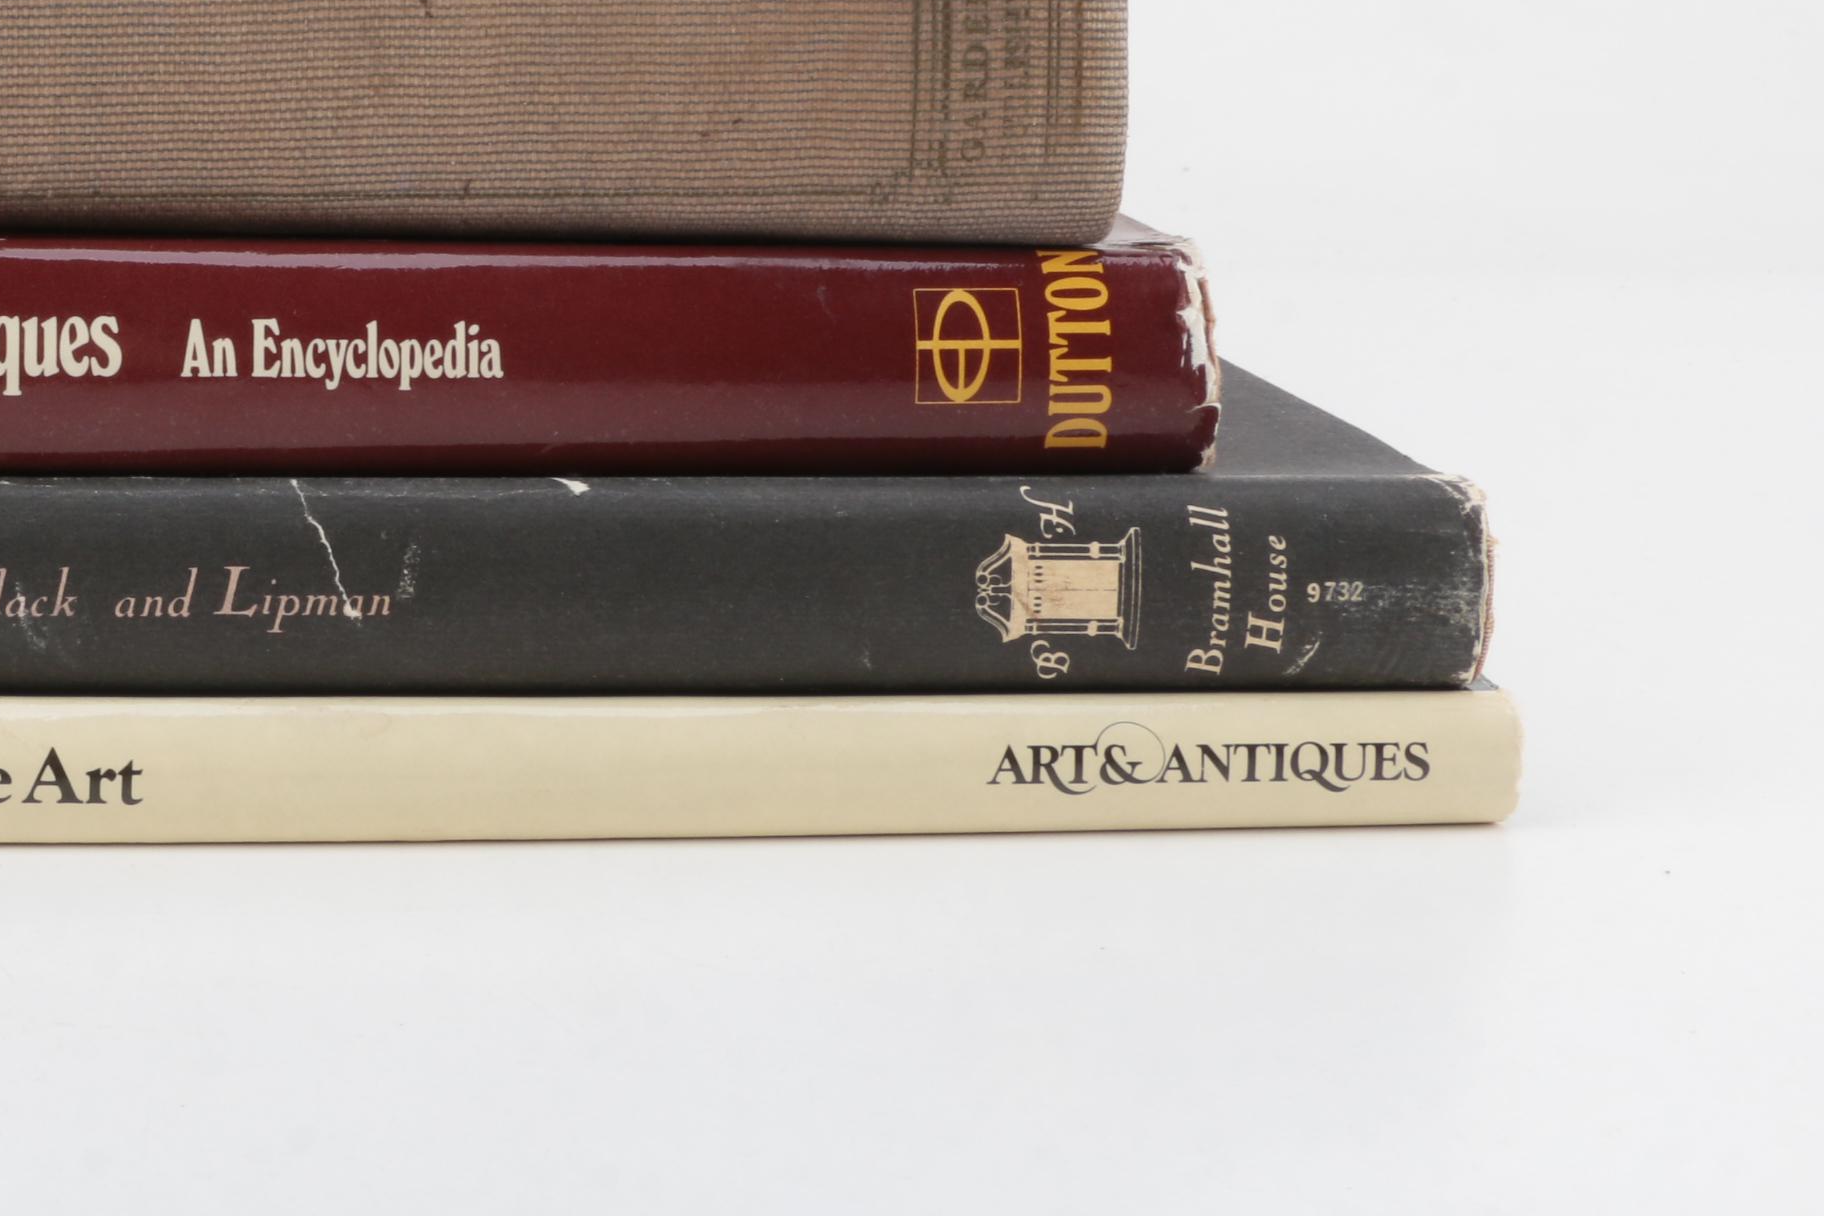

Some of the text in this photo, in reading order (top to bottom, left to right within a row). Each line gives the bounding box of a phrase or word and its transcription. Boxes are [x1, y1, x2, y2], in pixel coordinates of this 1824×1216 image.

[181, 318, 503, 390] An Encyclopedia
[1036, 250, 1112, 449] DUTTON
[115, 569, 193, 620] and
[213, 565, 392, 633] Lipman
[1184, 504, 1229, 675] Bramhall
[1244, 534, 1287, 653] House
[1306, 581, 1364, 603] 9732
[21, 746, 143, 805] Art
[1155, 741, 1430, 792] ANTIQUES
